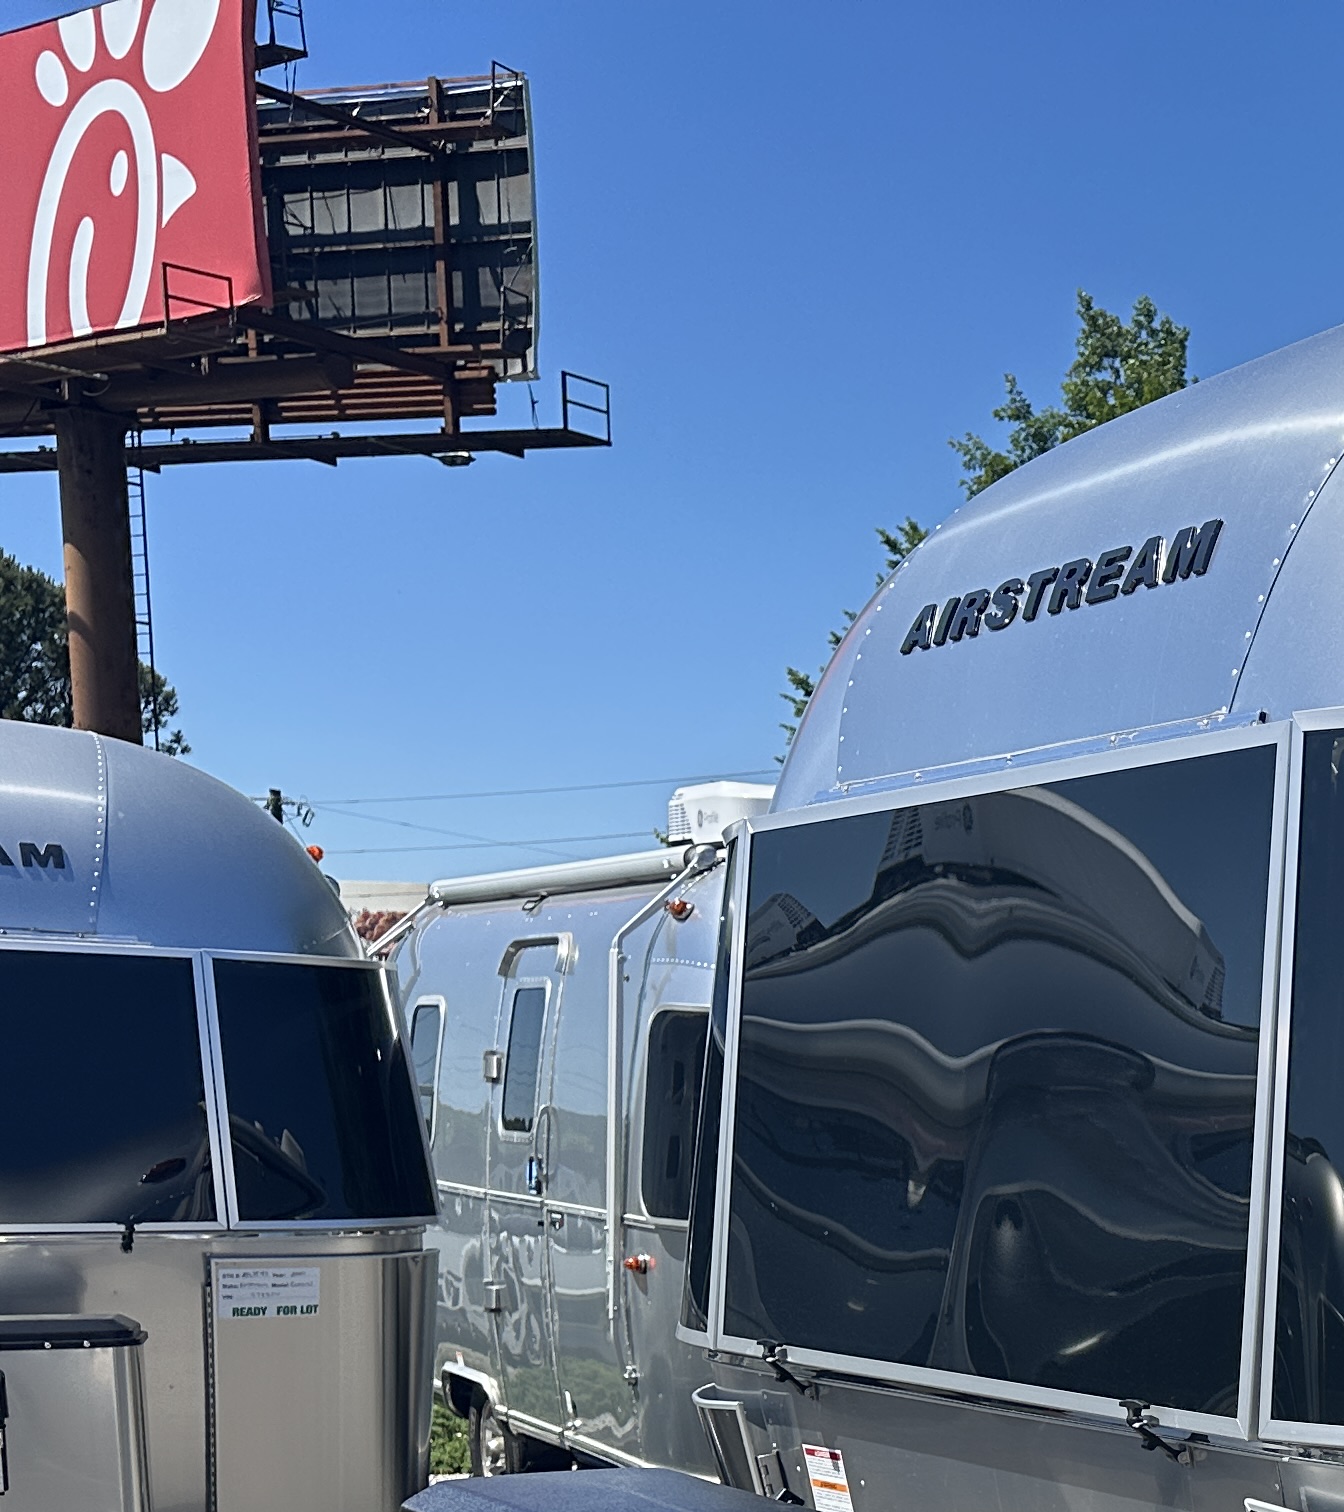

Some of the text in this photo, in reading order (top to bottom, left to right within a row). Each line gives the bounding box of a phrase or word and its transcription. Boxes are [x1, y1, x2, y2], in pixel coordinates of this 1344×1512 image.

[900, 518, 1223, 655] AIRSTREAM
[232, 1303, 319, 1318] READY FOR LOT
